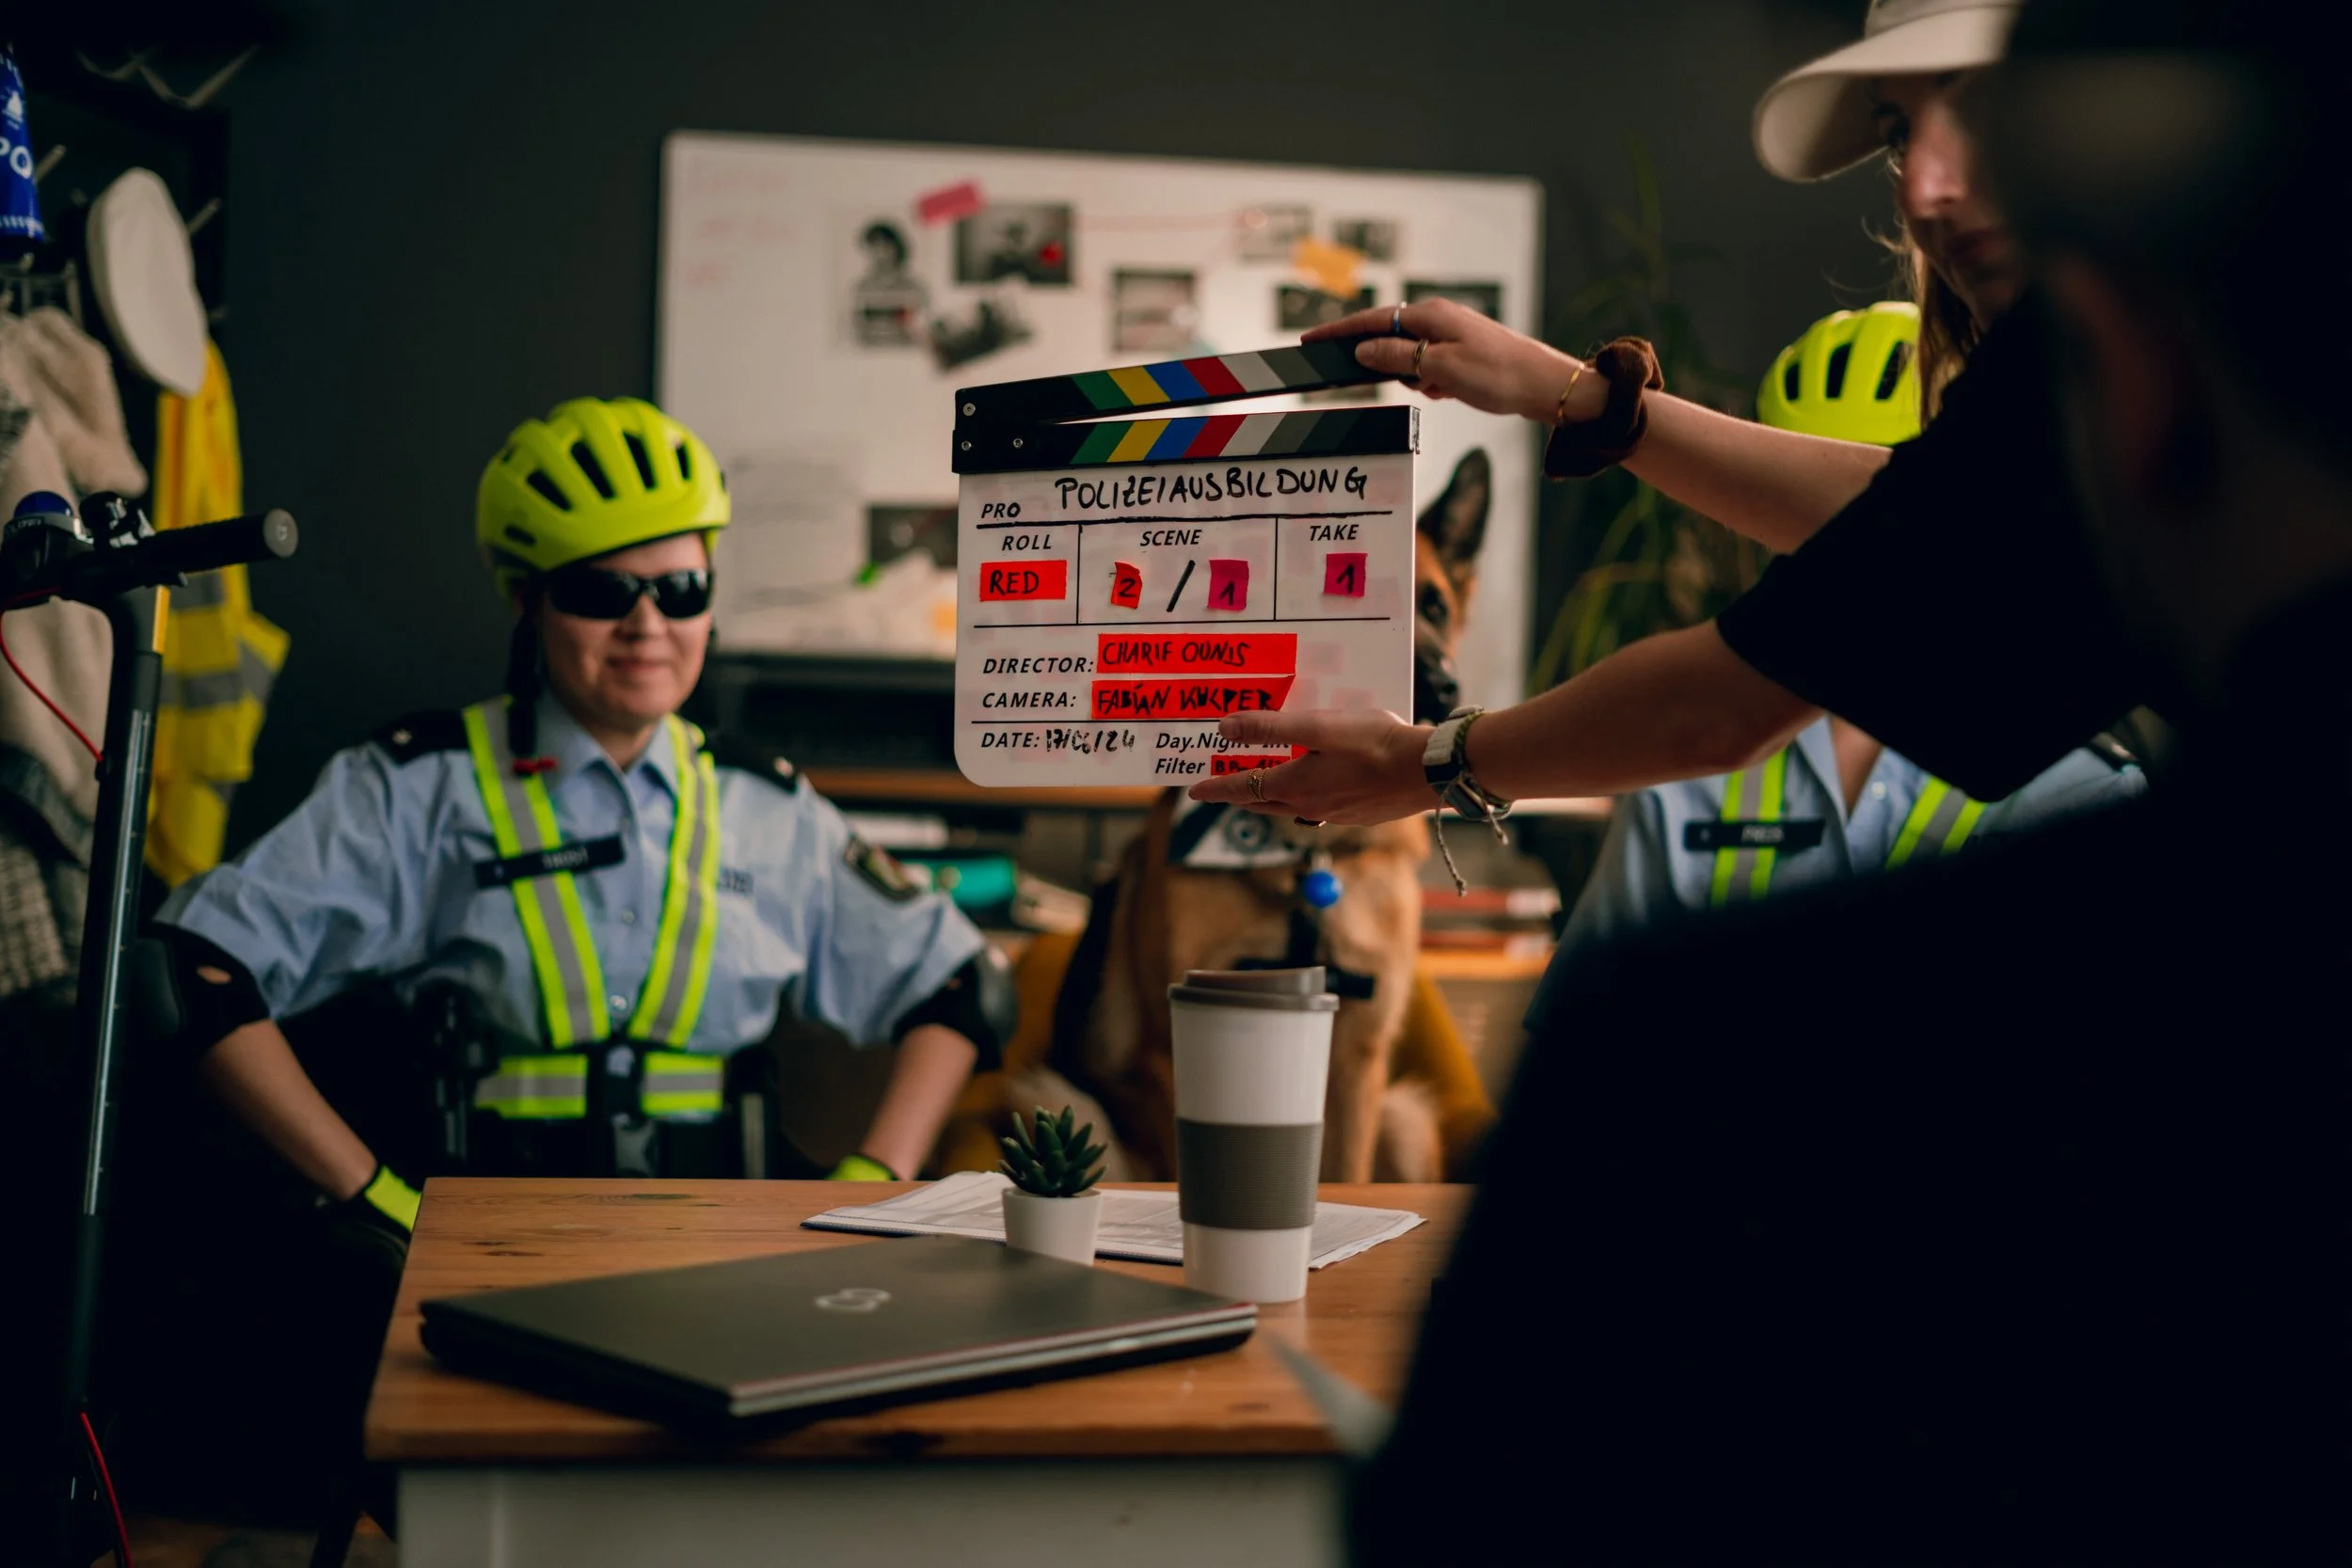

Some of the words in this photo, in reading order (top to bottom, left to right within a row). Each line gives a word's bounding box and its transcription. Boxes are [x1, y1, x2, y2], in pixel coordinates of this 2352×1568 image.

[1055, 467, 1367, 510] POLIZEIAUSBILDUNG
[981, 502, 1022, 518] PRO
[1140, 530, 1202, 546] SCENE
[1310, 524, 1359, 541] TAKE
[1002, 534, 1052, 551] ROLL
[990, 569, 1040, 595] RED
[1336, 563, 1355, 594] 1
[1118, 578, 1137, 597] 2
[1219, 580, 1234, 606] 1
[1102, 641, 1173, 666] CHARIF
[983, 657, 1094, 673] DIRECTOR:
[982, 691, 1077, 708] CAMERA:
[980, 732, 1041, 748] DATE:
[1154, 758, 1206, 774] Filter
